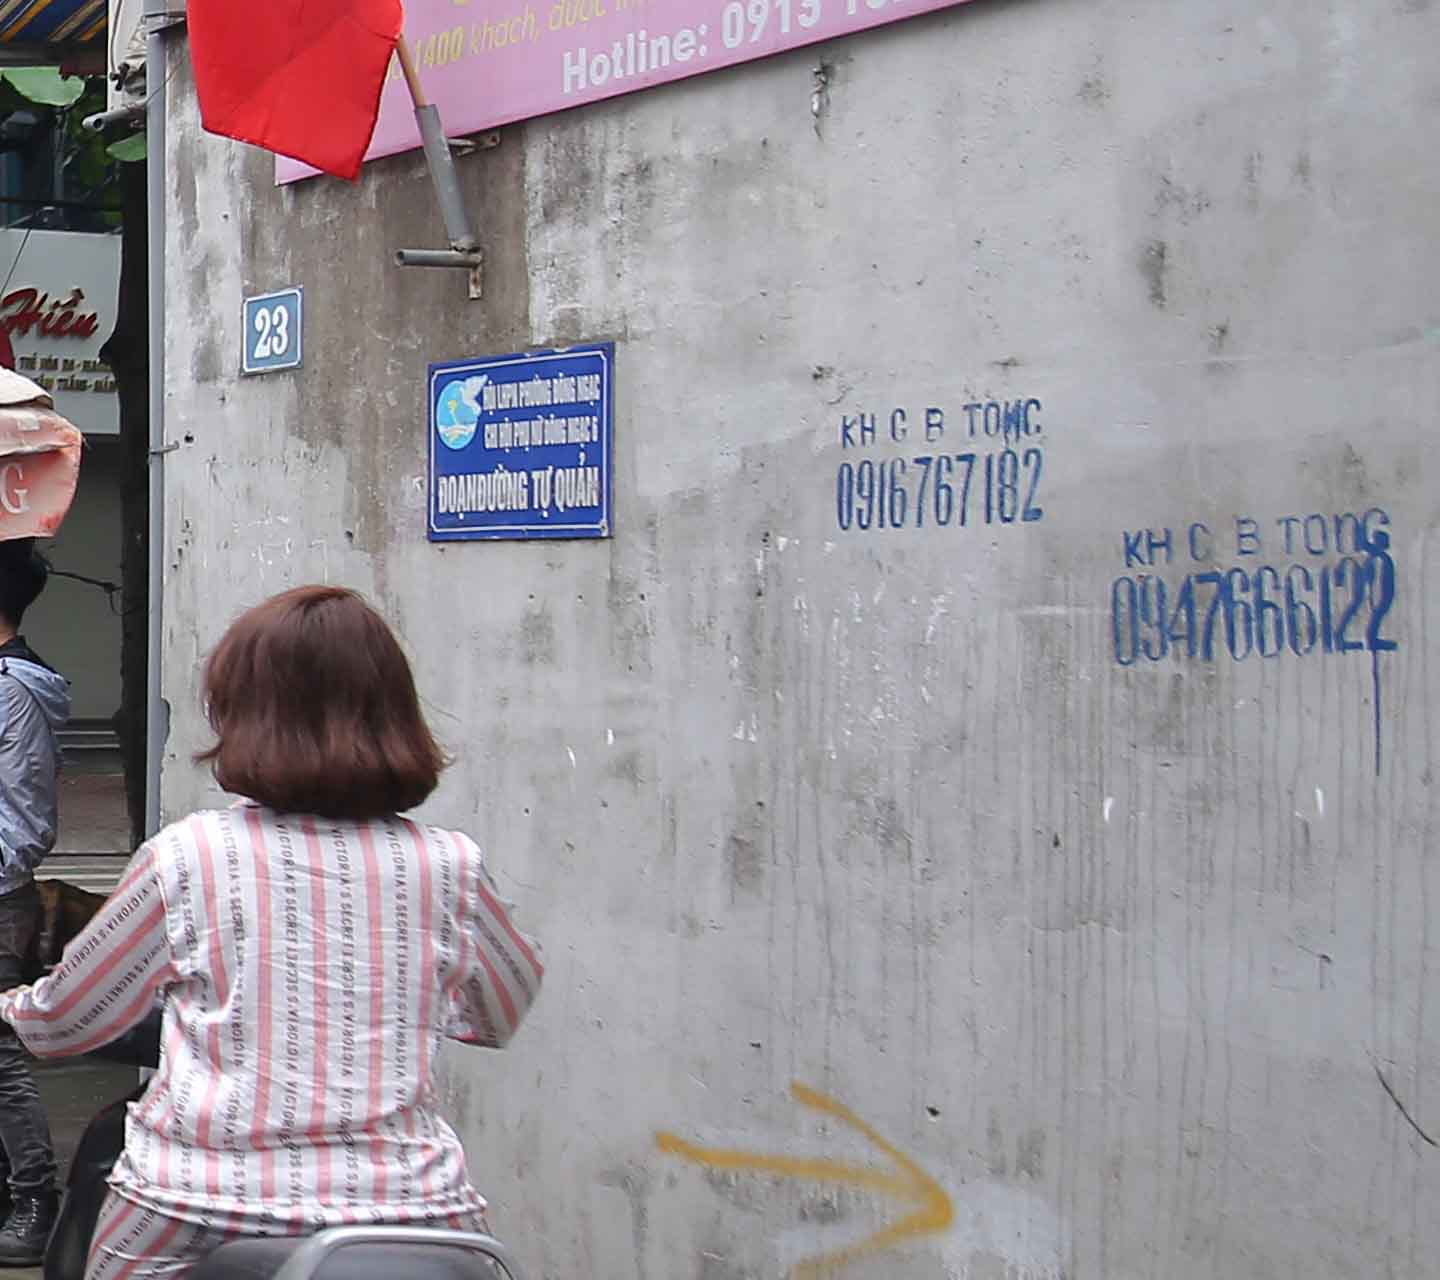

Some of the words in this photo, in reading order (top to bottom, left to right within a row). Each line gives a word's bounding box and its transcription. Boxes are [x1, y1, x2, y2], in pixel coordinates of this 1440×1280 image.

[560, 21, 711, 95] Hotline:
[254, 303, 290, 360] 23
[531, 464, 555, 519] TỰ
[554, 451, 600, 513] QUẢN
